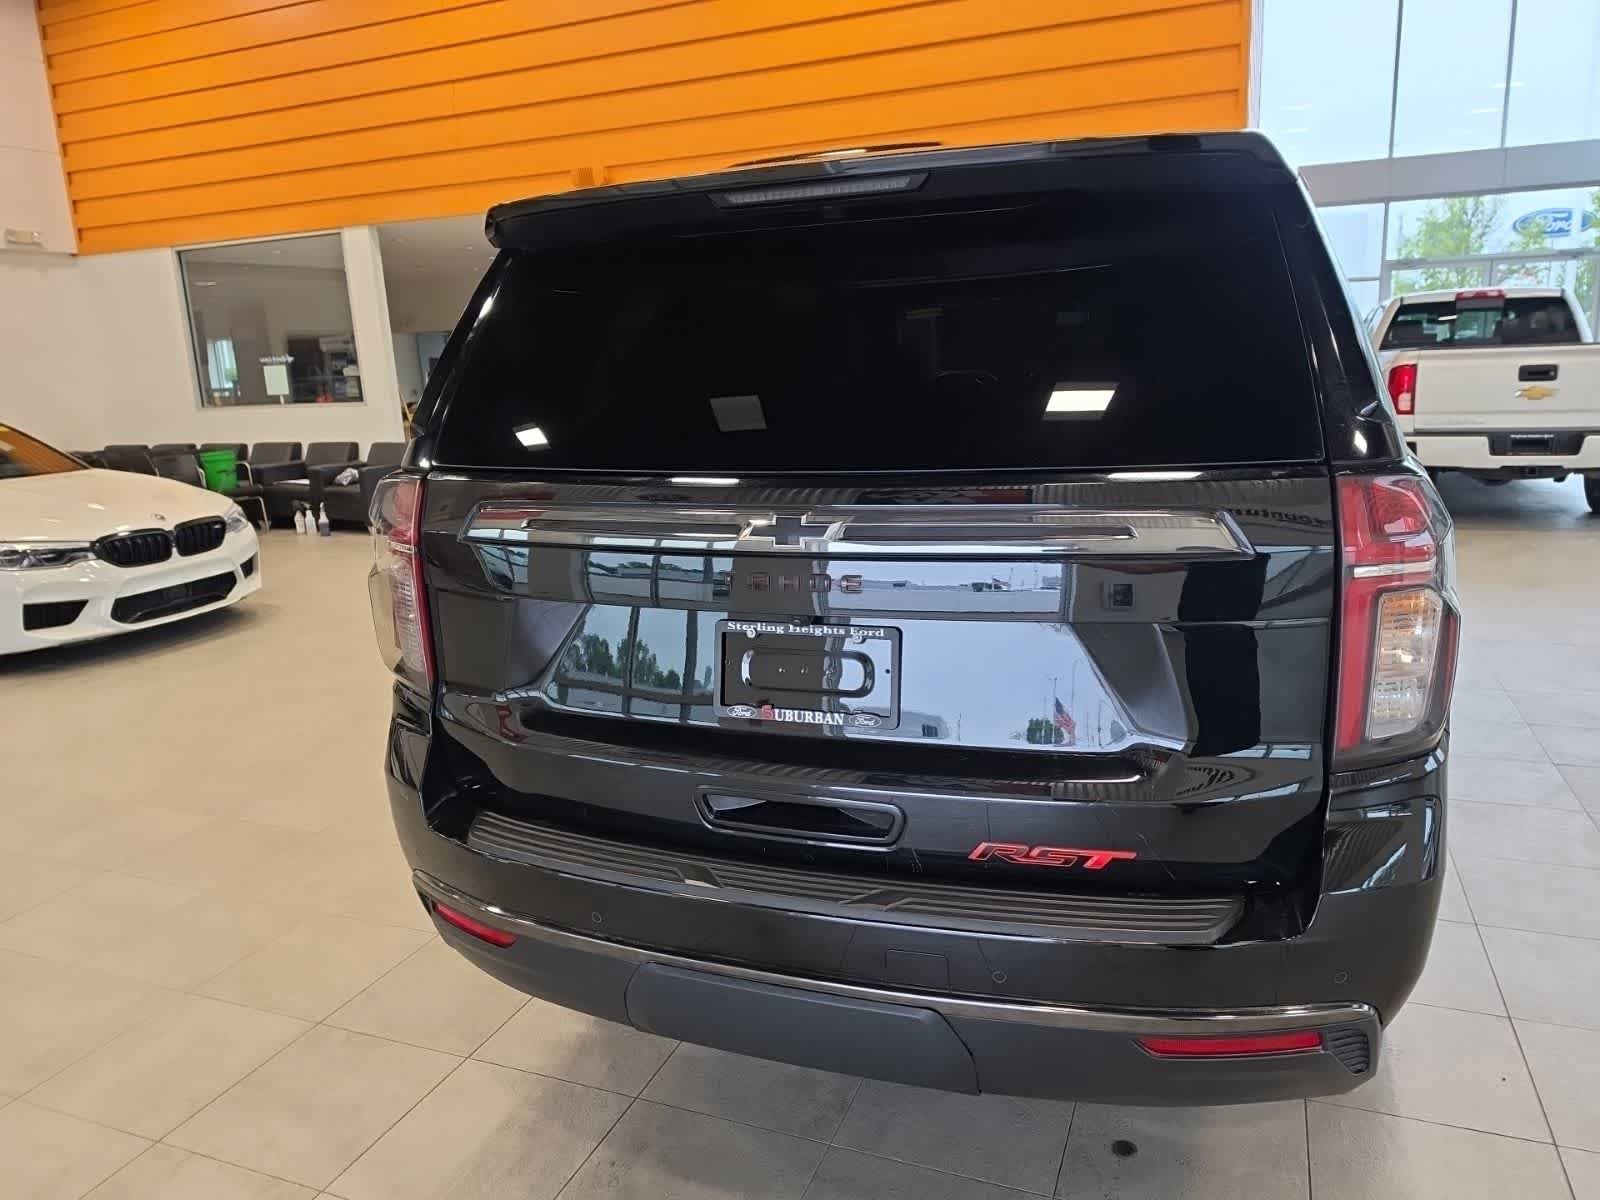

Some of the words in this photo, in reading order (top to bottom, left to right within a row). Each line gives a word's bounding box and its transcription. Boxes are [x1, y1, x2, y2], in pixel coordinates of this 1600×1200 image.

[727, 621, 785, 635] Sterling
[788, 624, 846, 637] Heights
[850, 626, 885, 639] Ford
[761, 704, 845, 725] SUBURBAN
[967, 841, 1137, 870] RST
